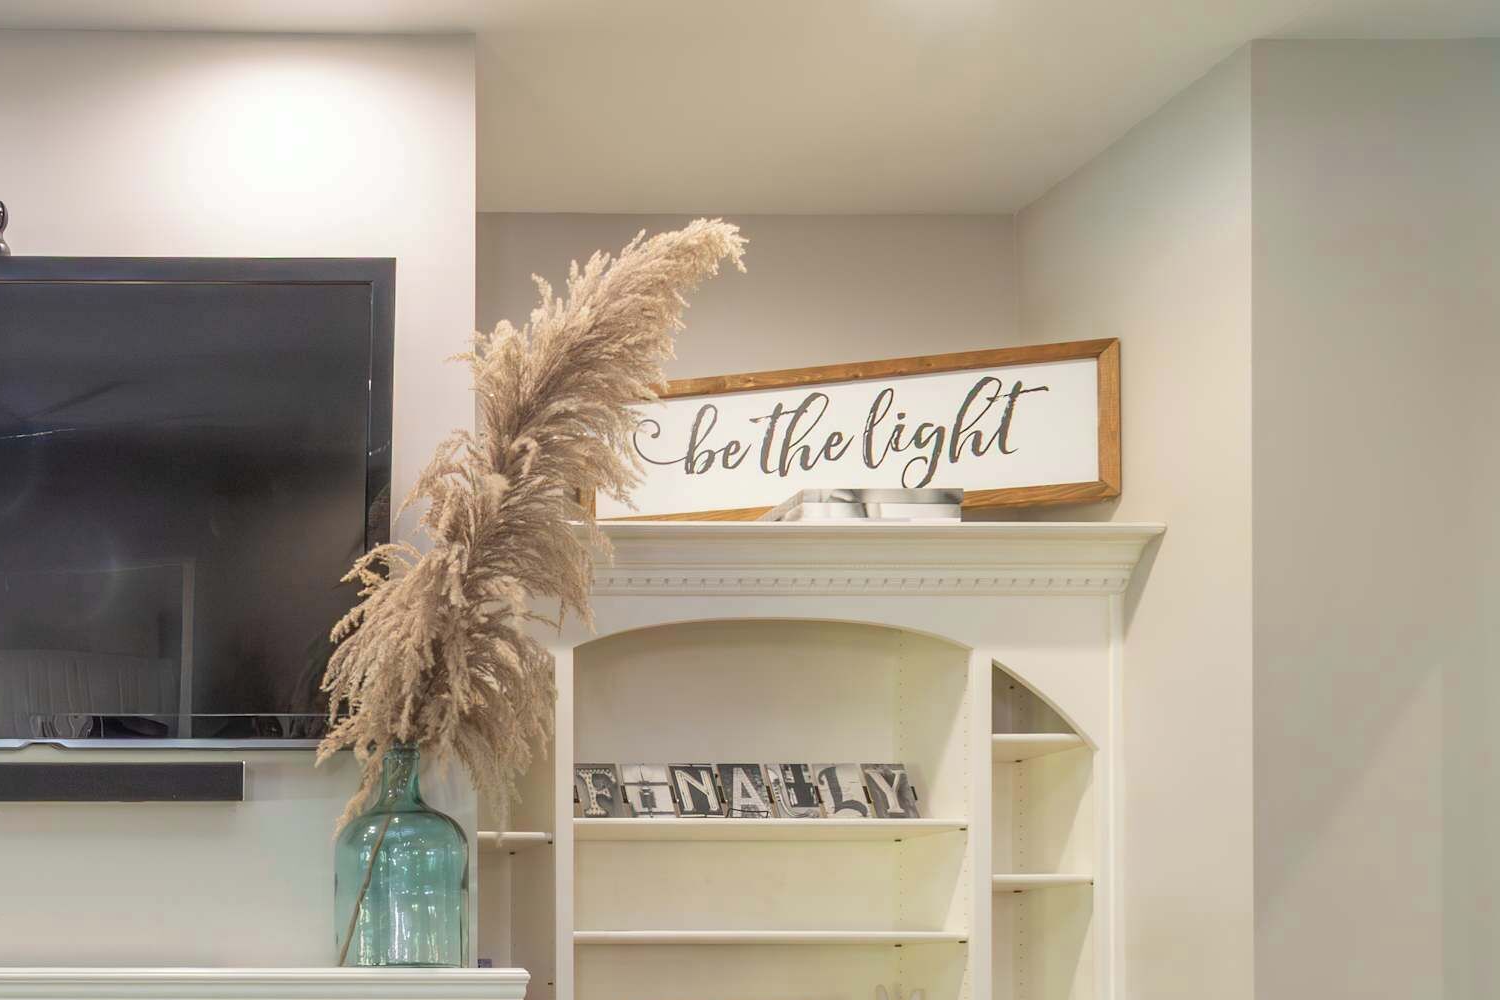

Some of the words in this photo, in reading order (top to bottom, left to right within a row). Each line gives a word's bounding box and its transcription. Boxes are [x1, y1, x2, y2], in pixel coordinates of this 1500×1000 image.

[633, 403, 751, 475] be
[750, 392, 854, 477] the
[862, 376, 1049, 488] light
[576, 765, 908, 817] FINALLY
